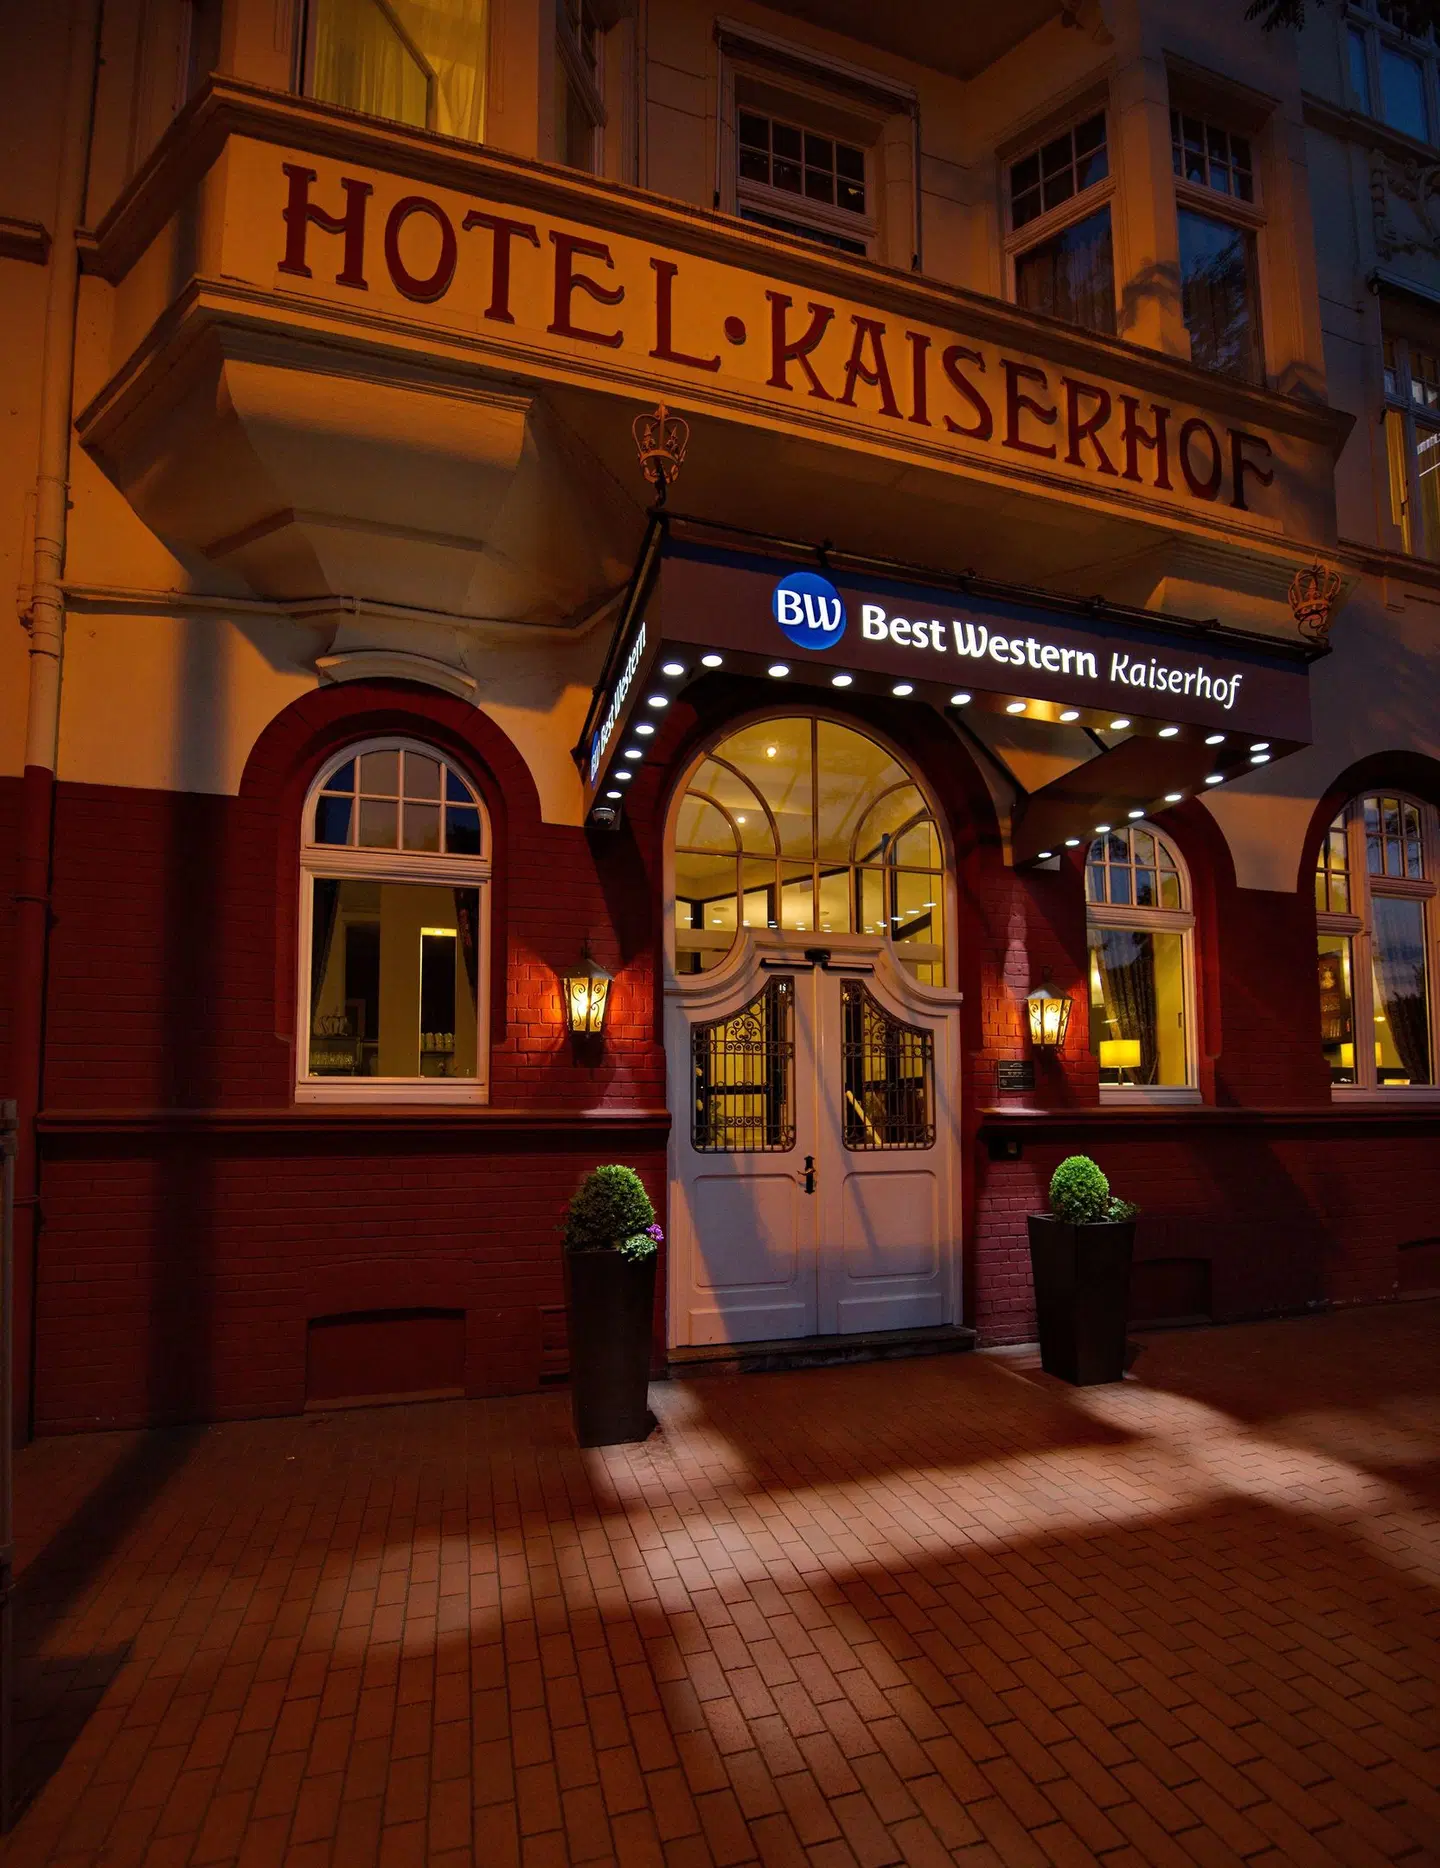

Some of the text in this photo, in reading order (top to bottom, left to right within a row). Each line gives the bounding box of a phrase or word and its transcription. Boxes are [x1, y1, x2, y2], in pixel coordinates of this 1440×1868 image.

[277, 162, 1275, 511] HOTEL KAISERHOF
[777, 589, 841, 631] BW
[862, 604, 1243, 709] Best Western Kaiserhof
[614, 621, 646, 720] Western
